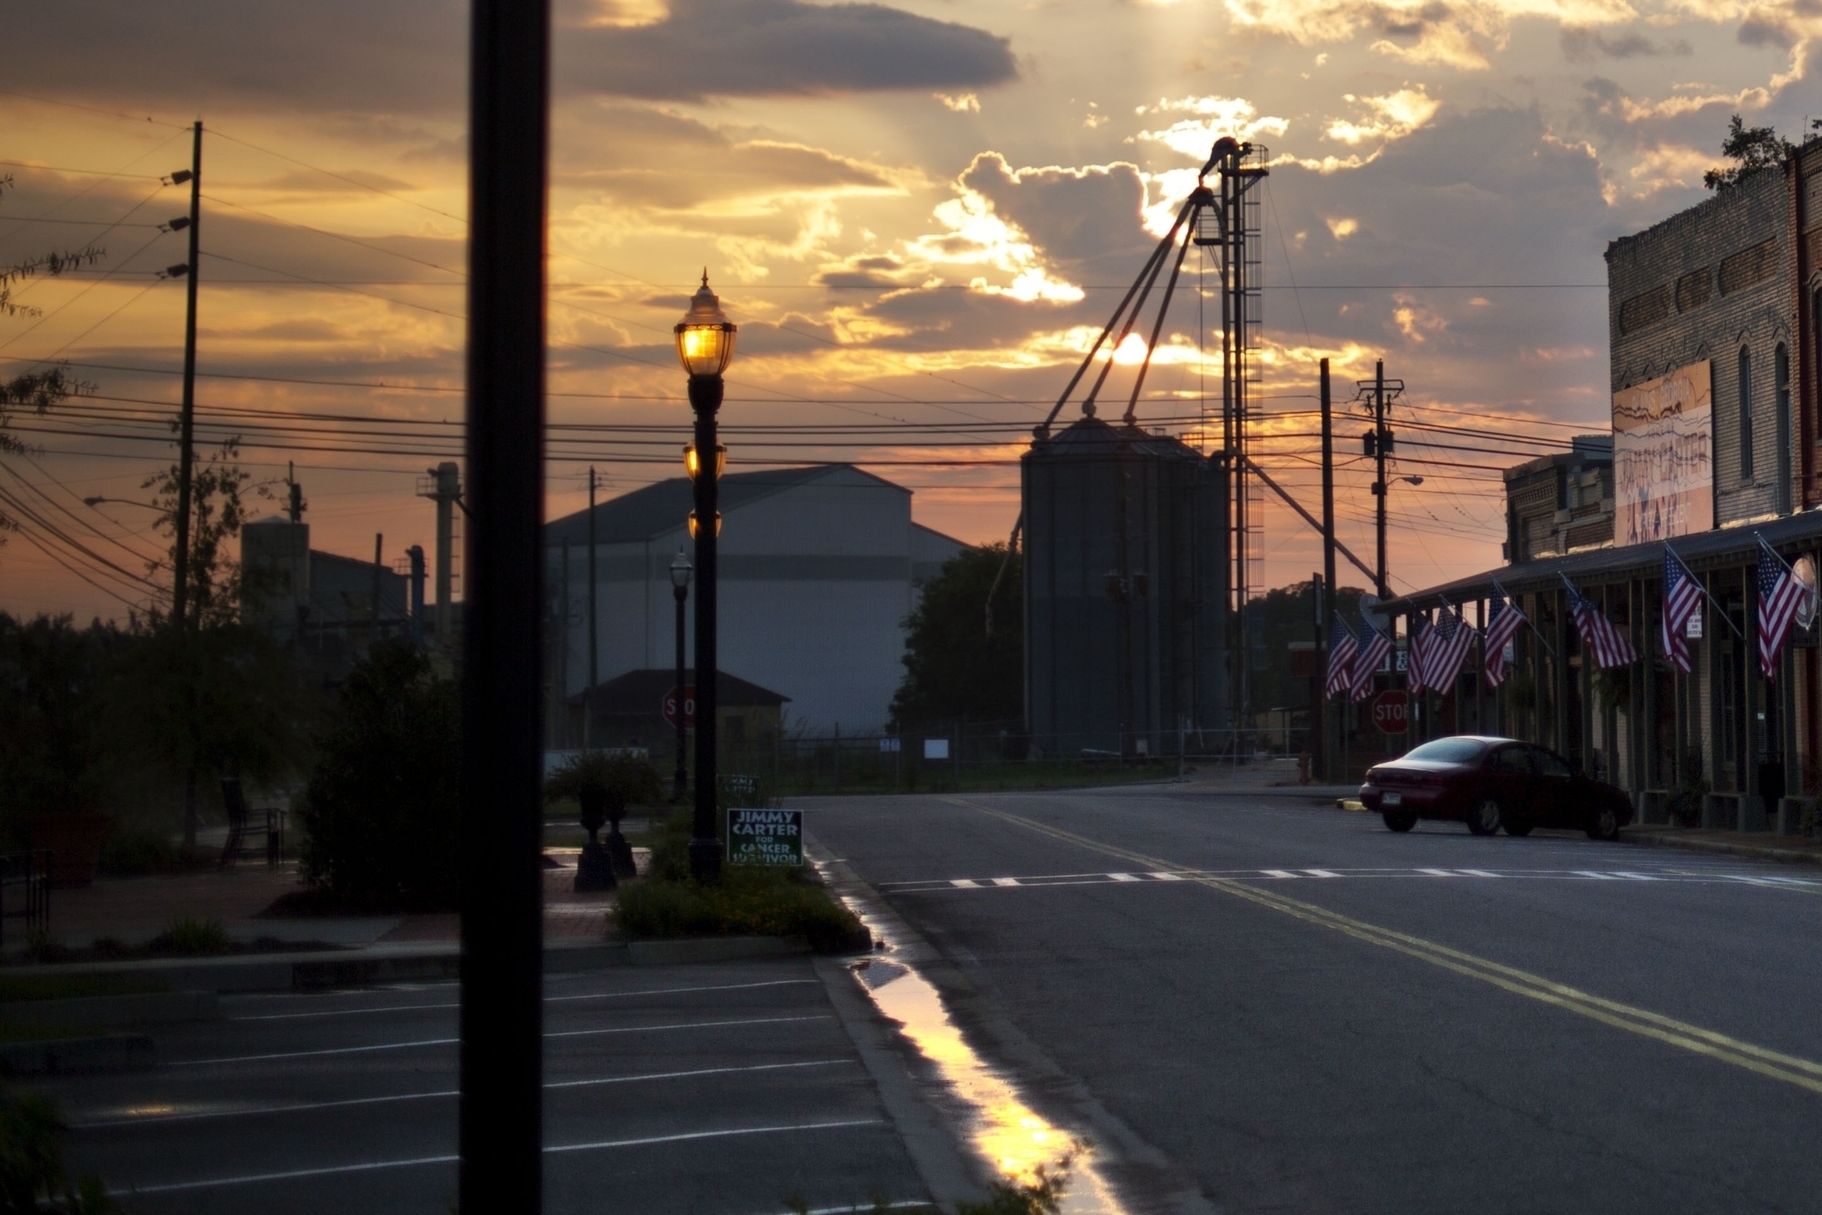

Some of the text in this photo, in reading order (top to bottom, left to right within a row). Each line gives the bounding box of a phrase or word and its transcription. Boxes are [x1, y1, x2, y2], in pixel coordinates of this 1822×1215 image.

[736, 811, 793, 823] JIMMY
[732, 823, 798, 835] CARTER
[740, 843, 790, 853] CANCER
